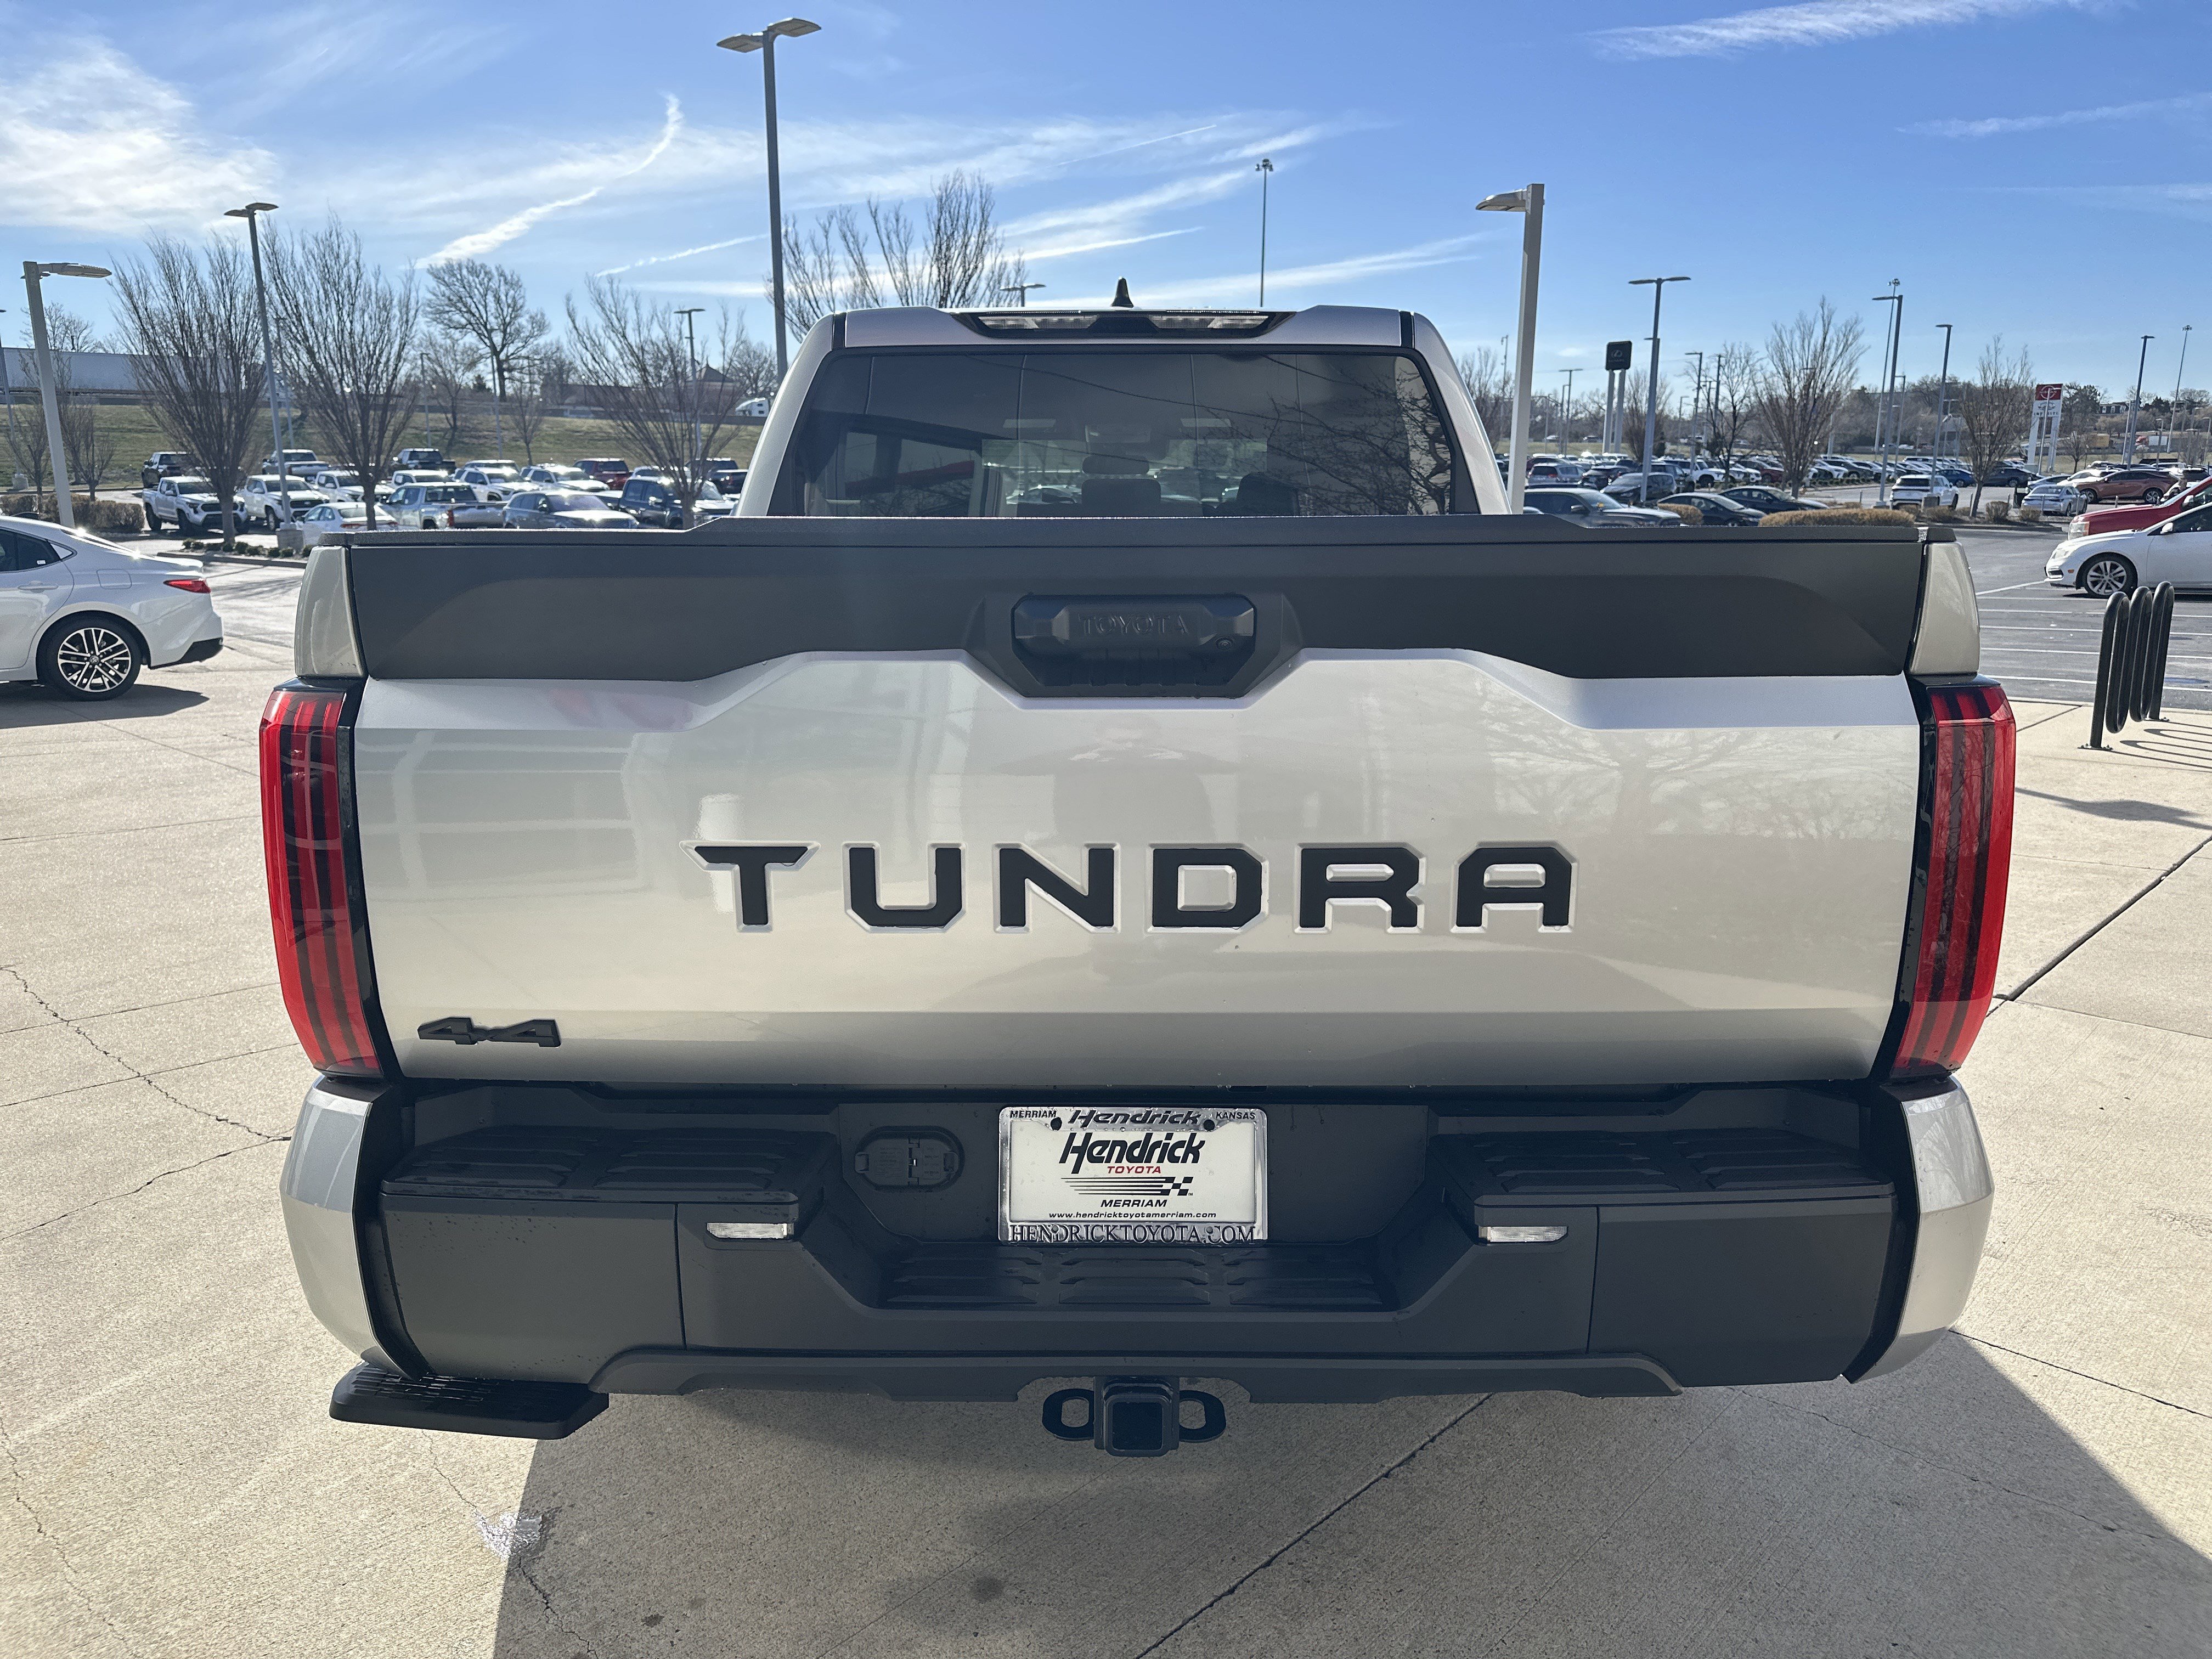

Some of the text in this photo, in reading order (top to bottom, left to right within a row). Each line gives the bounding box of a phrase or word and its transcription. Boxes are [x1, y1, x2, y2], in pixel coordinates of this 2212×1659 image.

[1079, 614, 1189, 635] TOYOTA
[684, 840, 1577, 932] TUNDRA
[1009, 1110, 1057, 1119] MERRIAM
[1068, 1109, 1202, 1128] Hendrick
[1216, 1111, 1256, 1120] KANSAS
[1059, 1132, 1205, 1174] Hendrick
[1107, 1166, 1161, 1174] TOYOTA
[1101, 1199, 1167, 1207] MERRIAM
[1009, 1224, 1256, 1244] HENDRICKTOYOTA.COM
